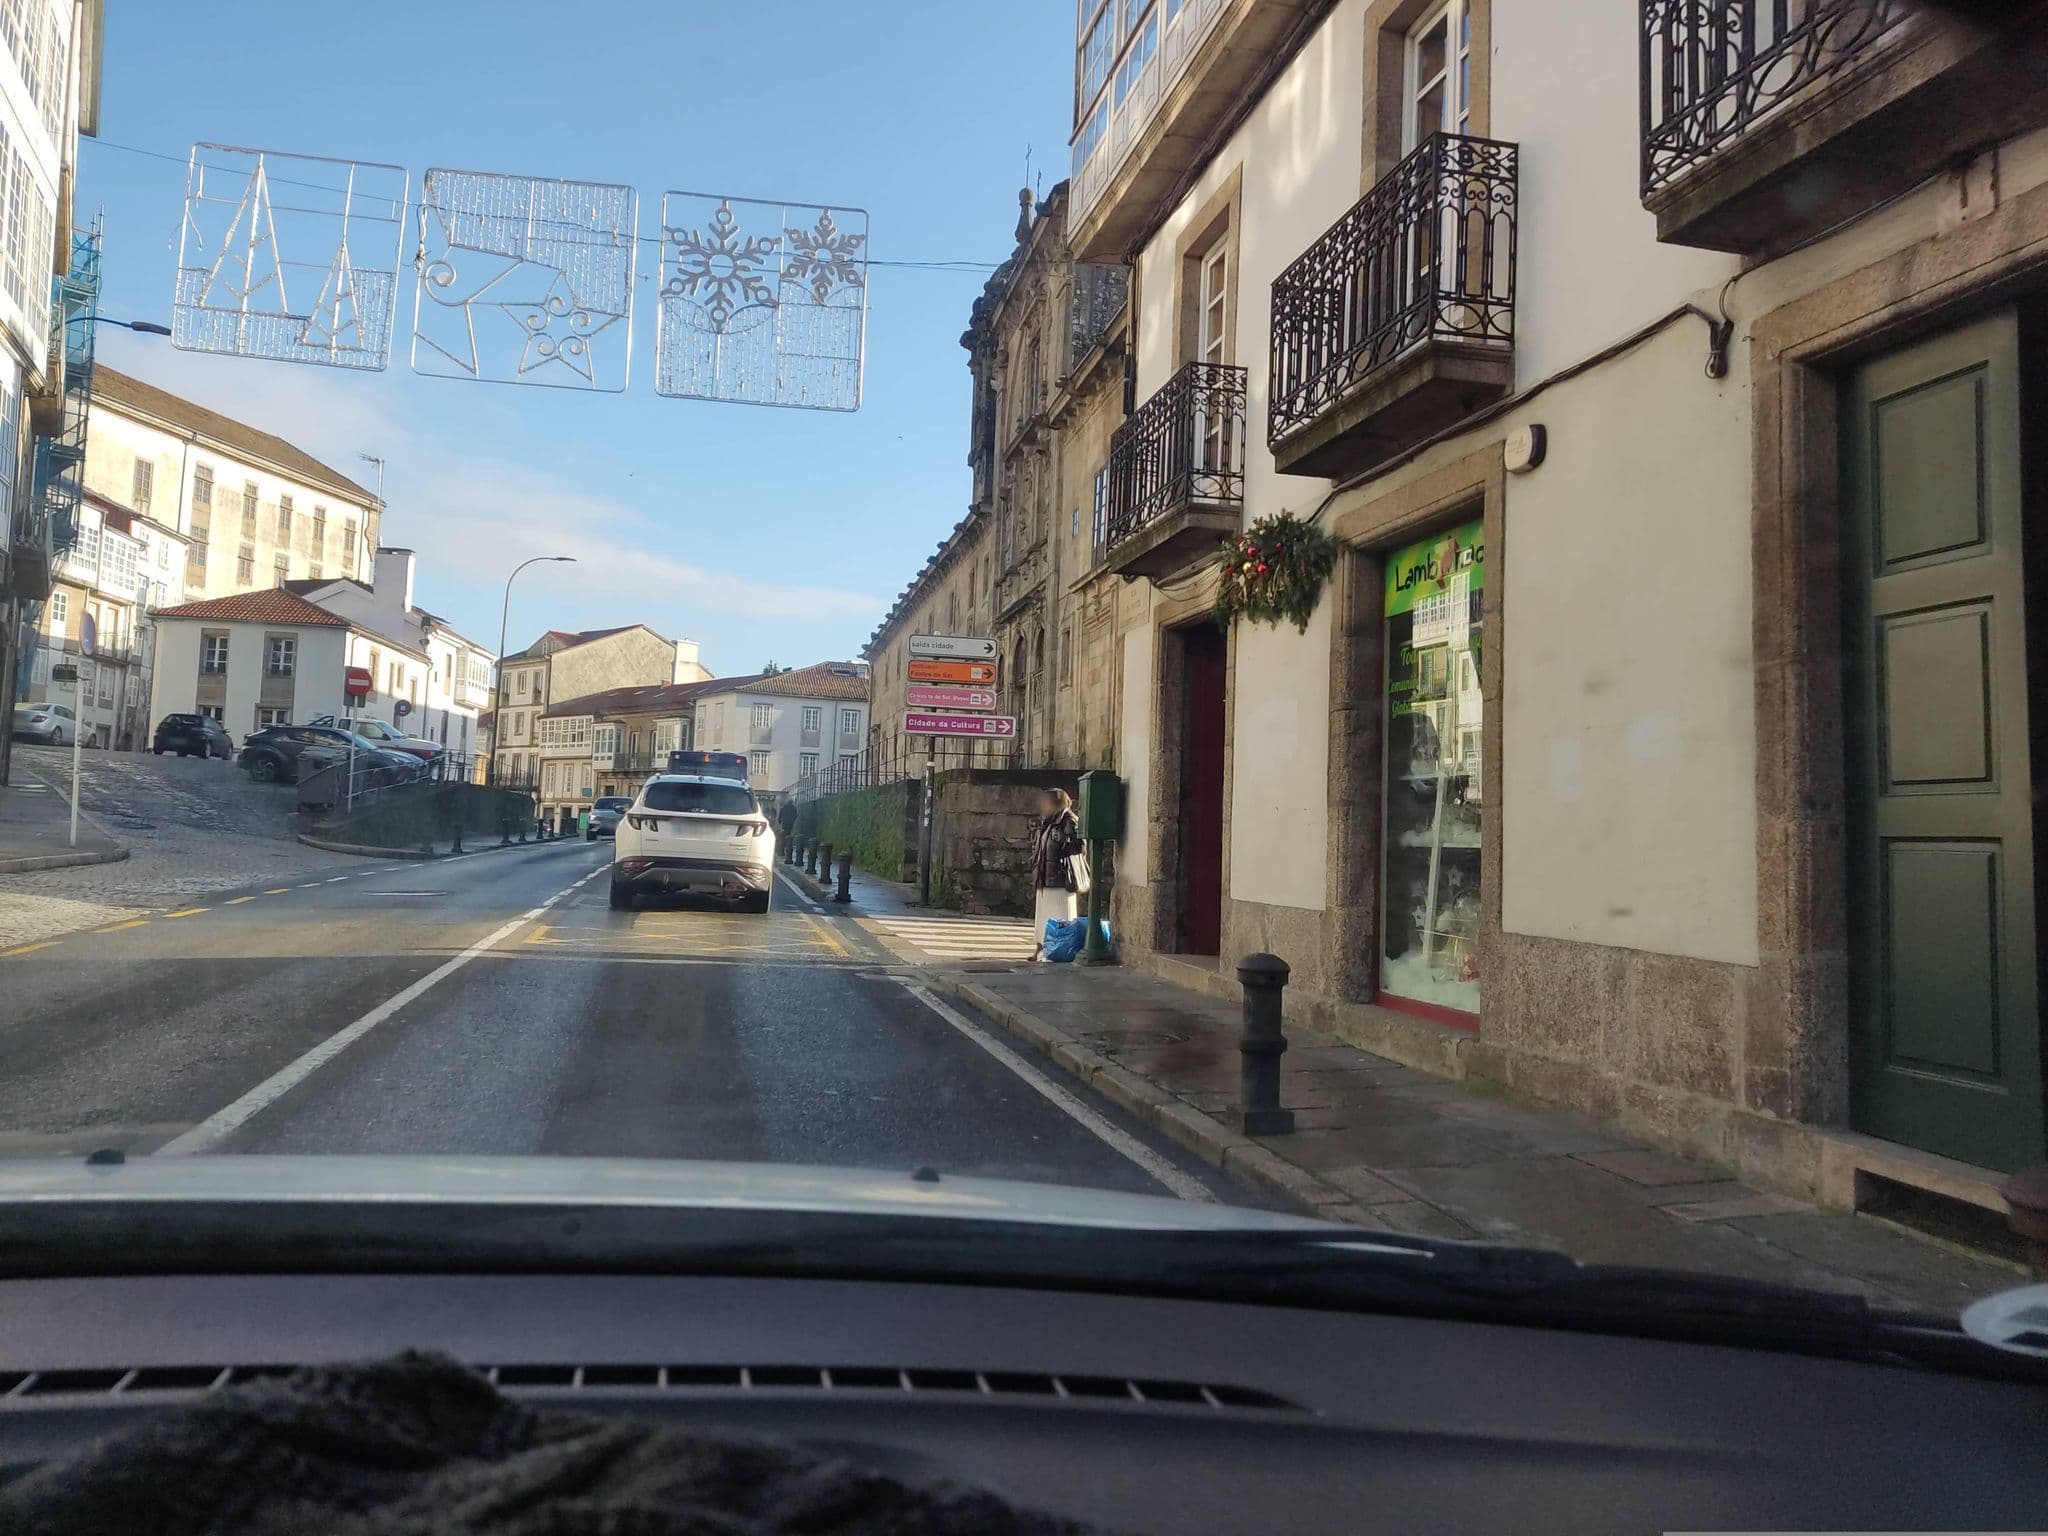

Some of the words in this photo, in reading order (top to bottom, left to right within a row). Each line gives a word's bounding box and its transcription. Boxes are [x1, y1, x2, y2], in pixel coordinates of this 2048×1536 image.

[931, 641, 954, 650] cidade
[908, 718, 935, 727] Cidade
[938, 719, 948, 728] da
[951, 720, 981, 730] Cultura
